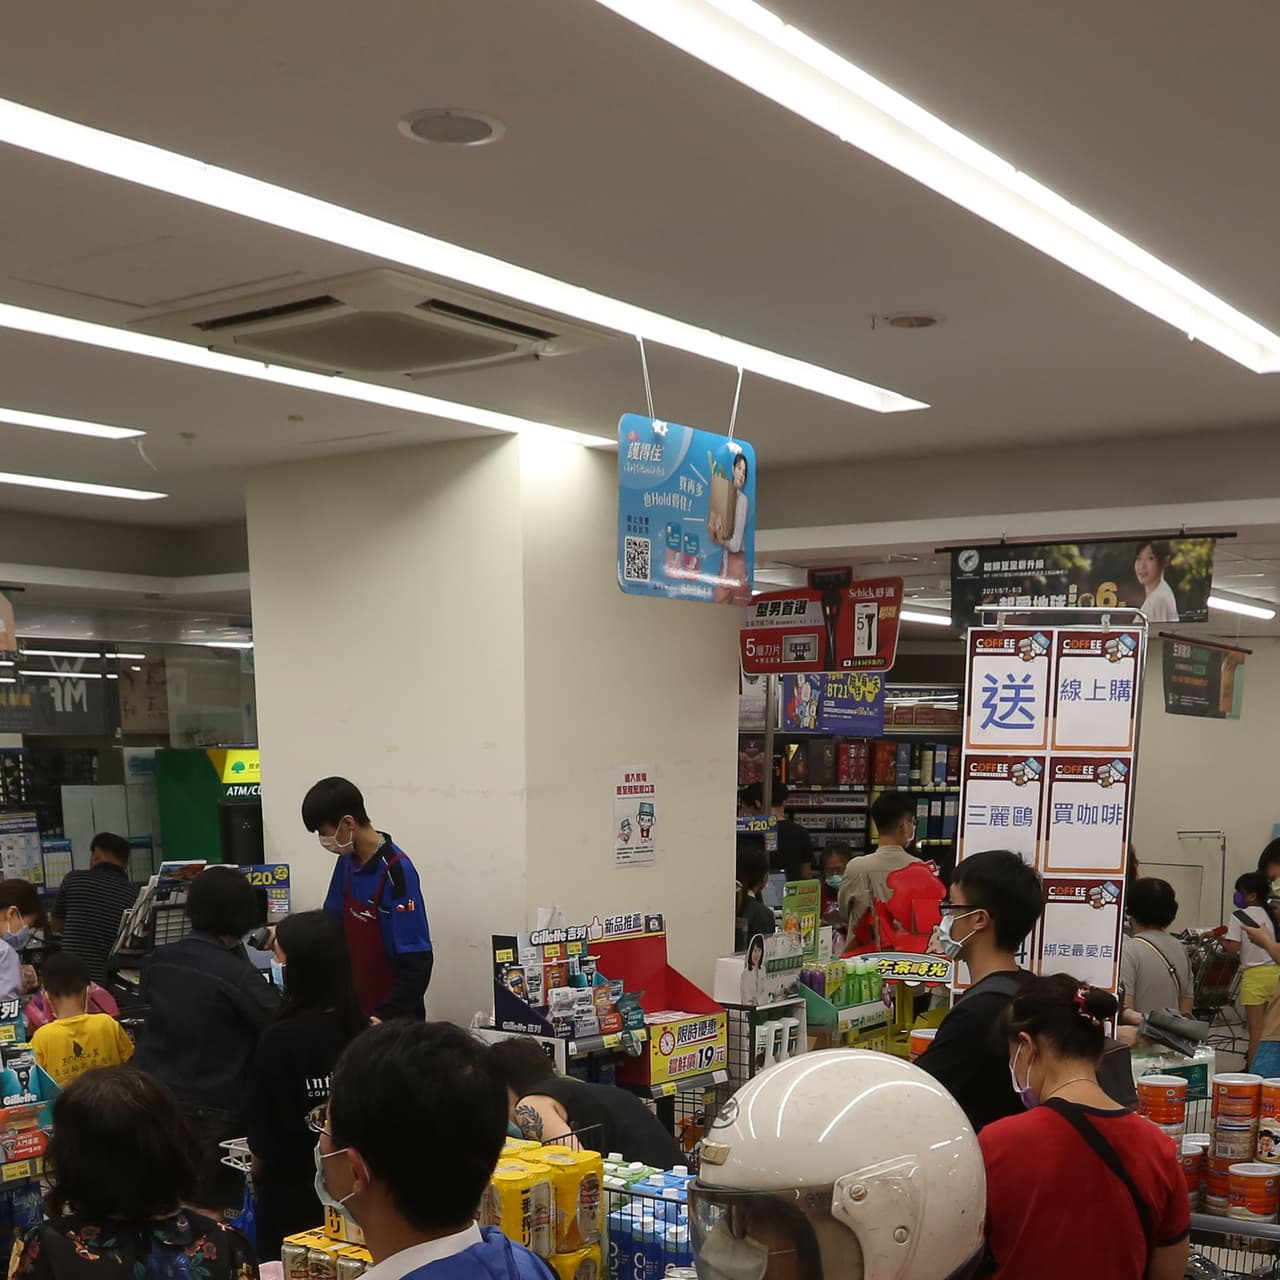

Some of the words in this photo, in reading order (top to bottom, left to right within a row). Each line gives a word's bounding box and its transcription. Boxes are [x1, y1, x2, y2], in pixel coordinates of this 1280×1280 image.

[848, 587, 875, 598] Schick
[756, 599, 809, 617] 型男首選
[976, 638, 1015, 650] COFFEE
[1063, 638, 1102, 650] COFFEE
[826, 684, 849, 699] BT21
[1060, 678, 1132, 702] 線上購
[980, 672, 1036, 730] 送
[970, 762, 1009, 773] COFFEE
[1055, 764, 1094, 776] COFFEE
[966, 805, 1033, 827] 三麗鷗
[1052, 803, 1123, 826] 買咖啡
[1048, 886, 1087, 897] COFFEE
[530, 930, 567, 946] Gillette
[567, 926, 587, 941] 吉列
[1044, 943, 1113, 959] 綁定最愛店
[676, 1018, 718, 1044] 限時優惠
[3, 1093, 38, 1107] Gillette
